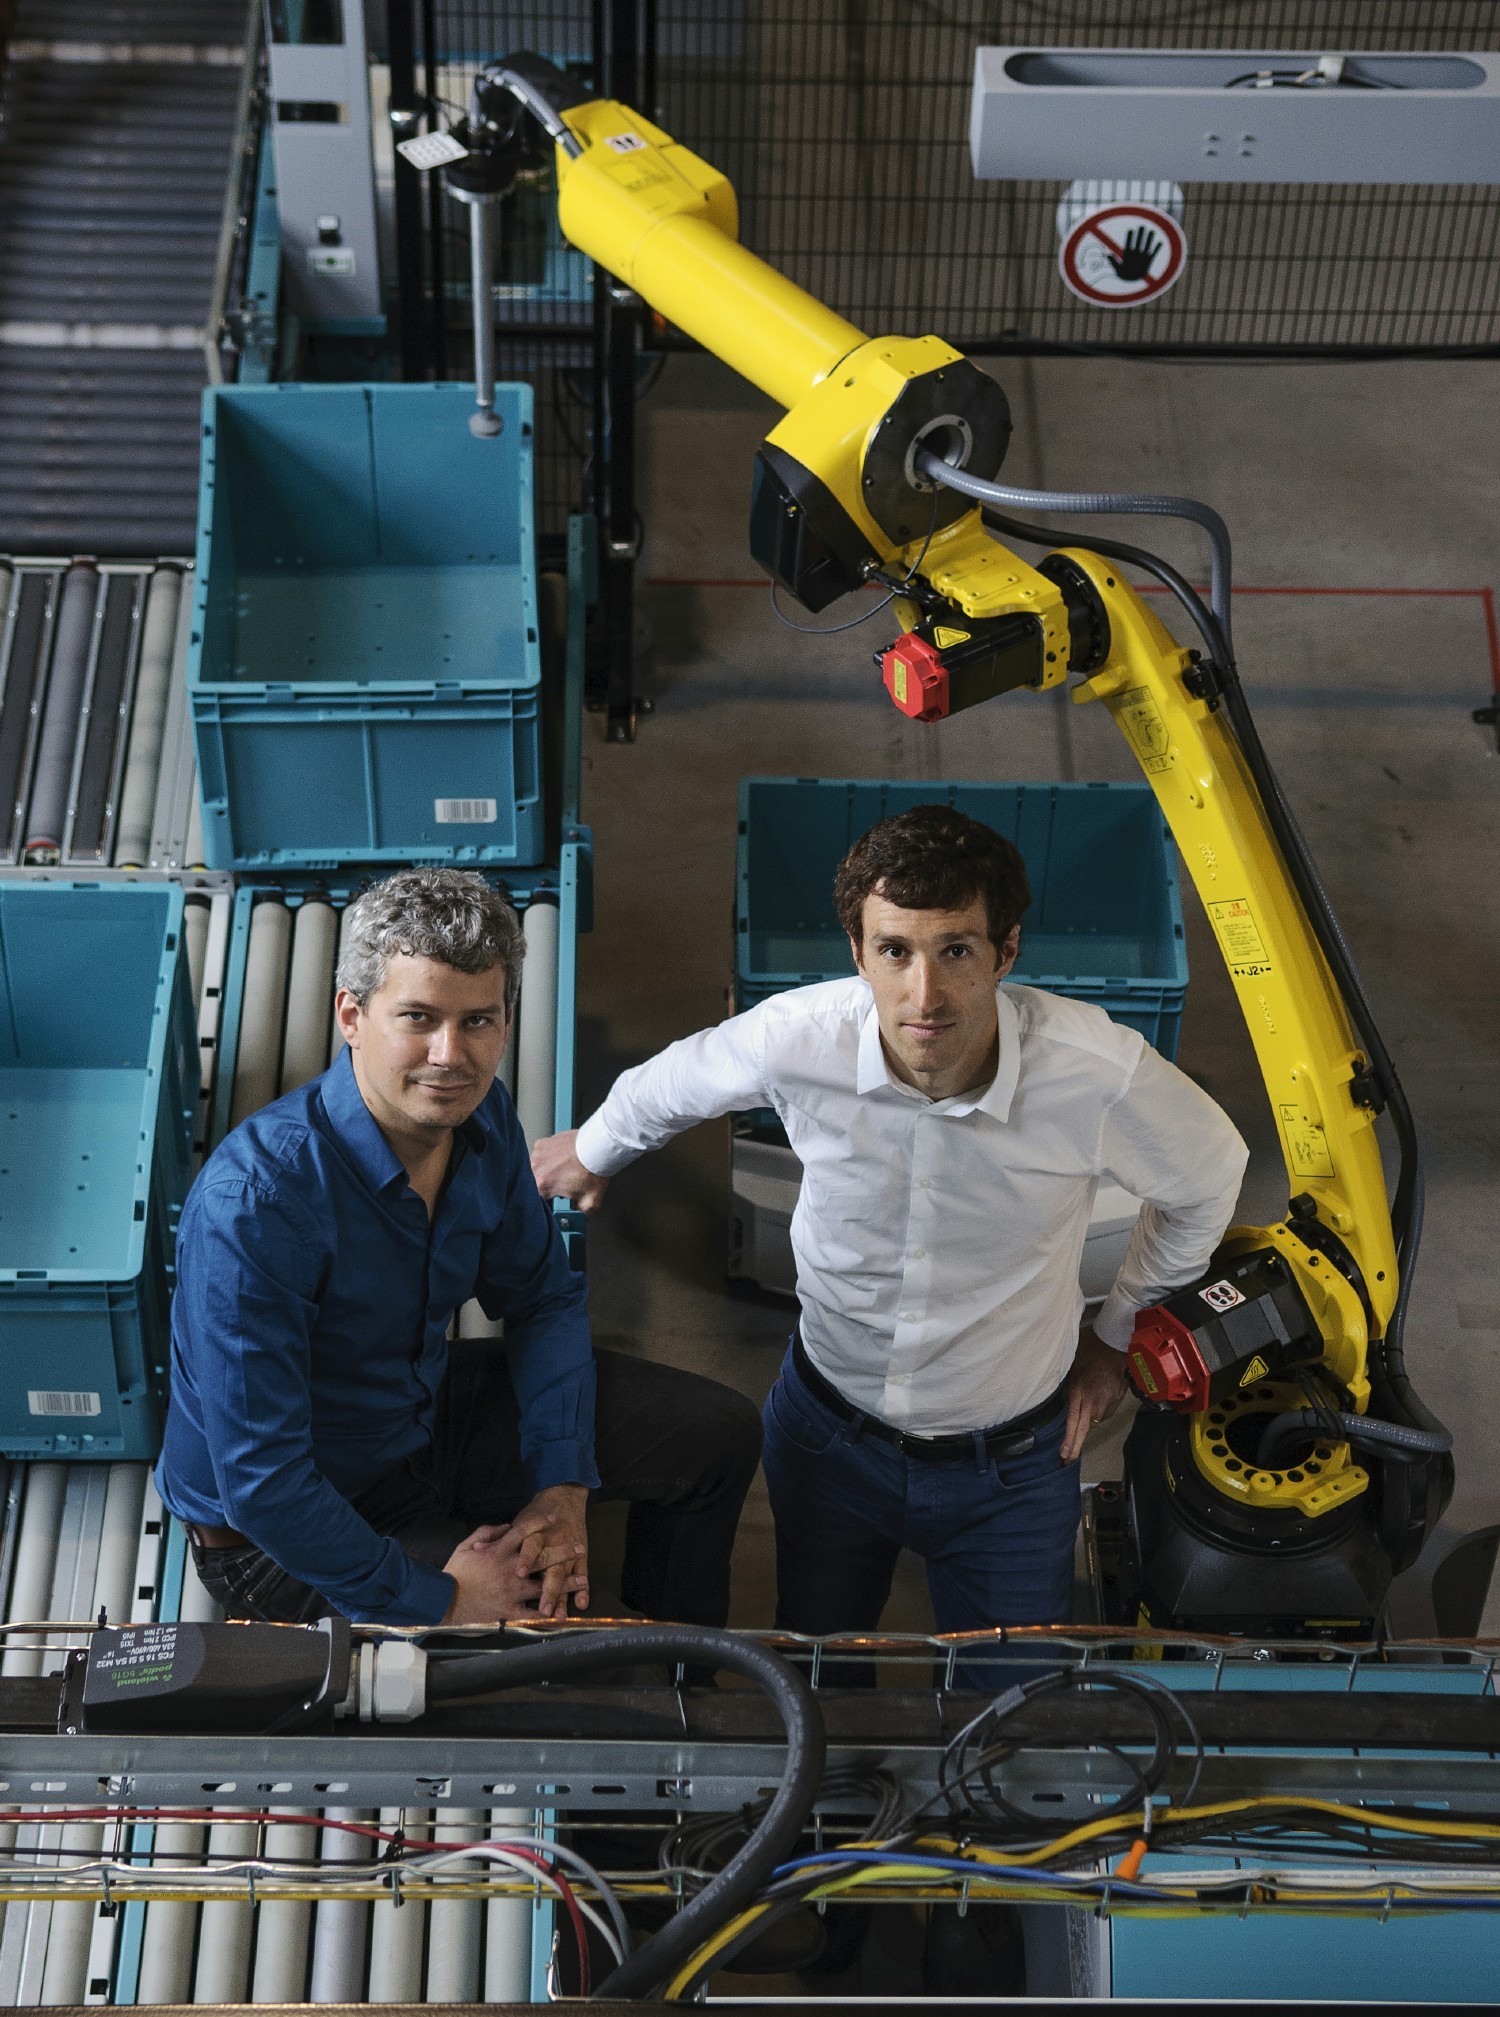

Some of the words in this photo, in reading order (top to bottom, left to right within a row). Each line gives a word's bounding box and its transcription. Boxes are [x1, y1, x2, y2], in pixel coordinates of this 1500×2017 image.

[144, 1628, 155, 1636] Nm
[120, 1639, 134, 1648] TX15
[146, 1653, 155, 1661] 16
[157, 1651, 174, 1660] FCS
[96, 1659, 113, 1668] M32
[115, 1657, 128, 1666] SA
[117, 1675, 158, 1688] wieland
